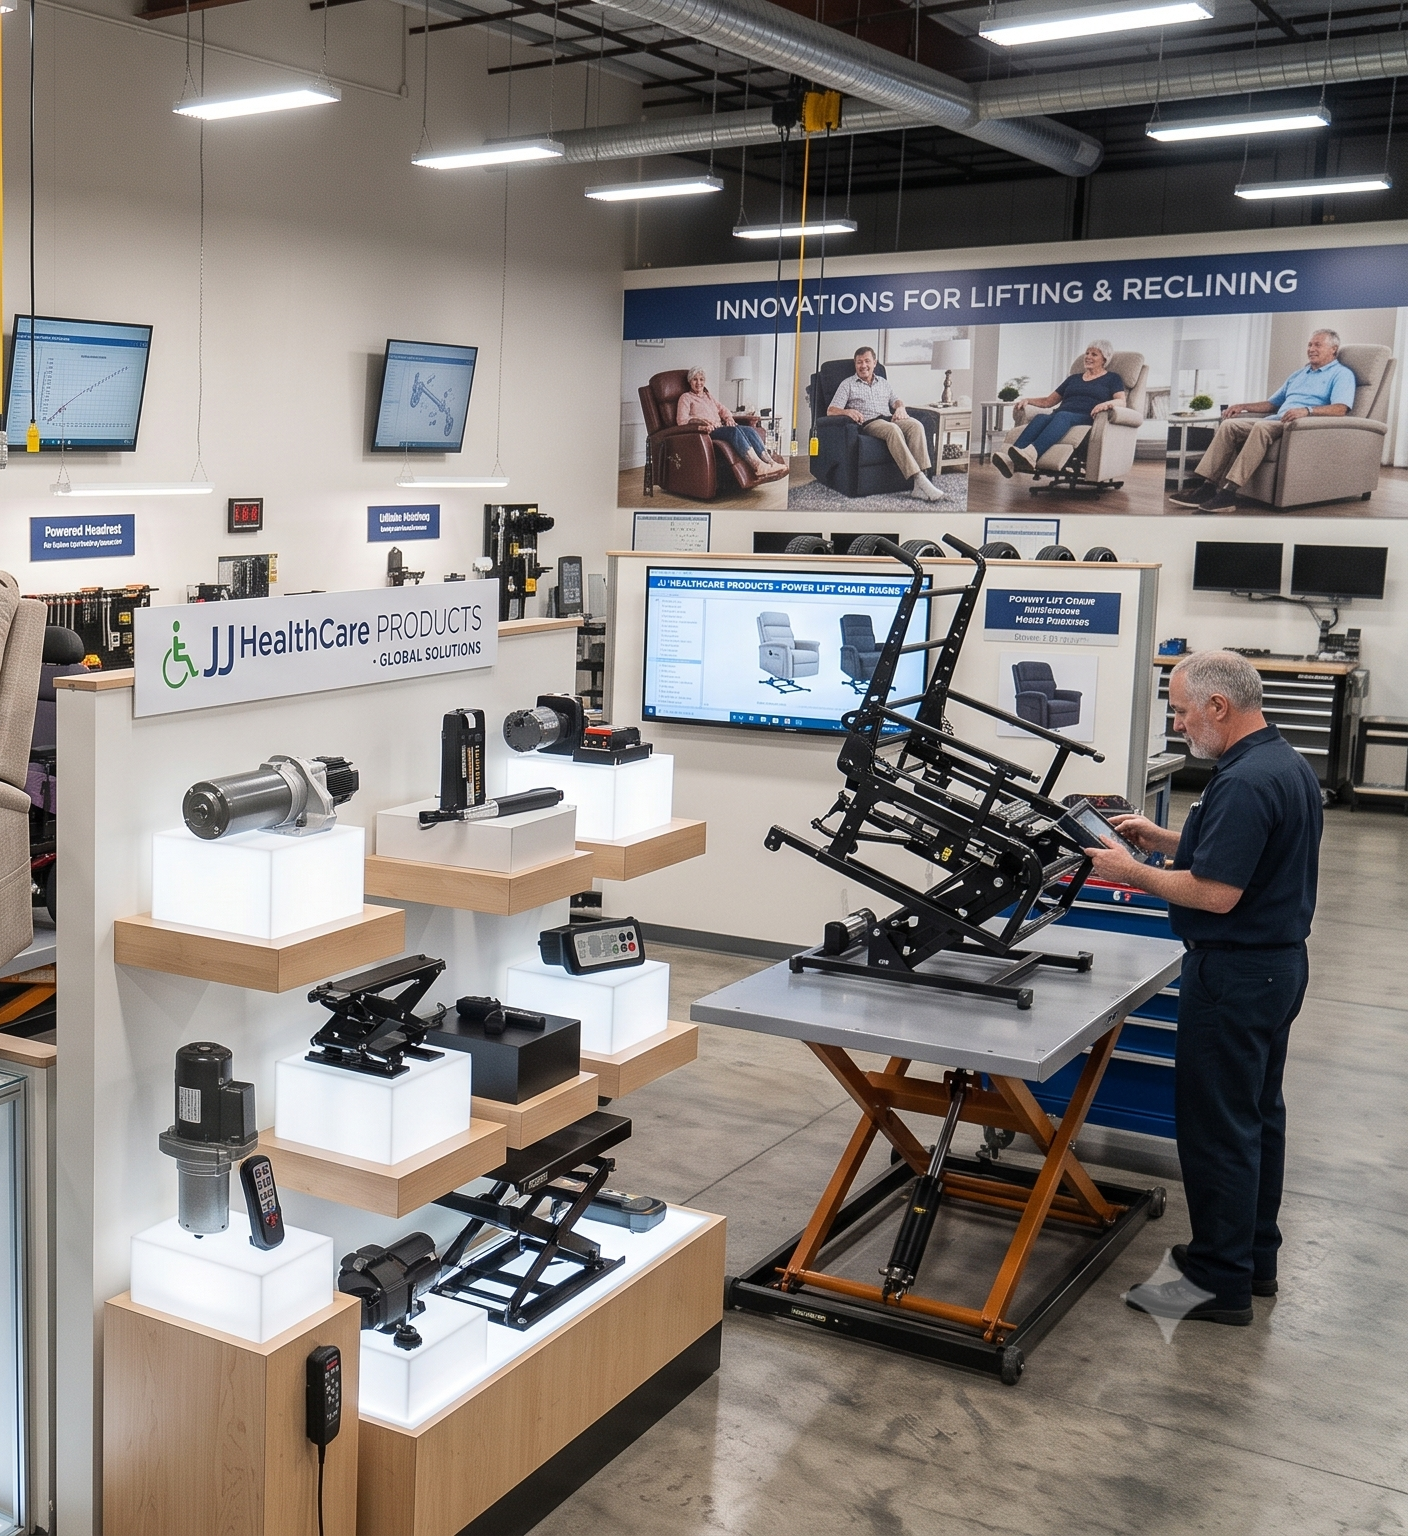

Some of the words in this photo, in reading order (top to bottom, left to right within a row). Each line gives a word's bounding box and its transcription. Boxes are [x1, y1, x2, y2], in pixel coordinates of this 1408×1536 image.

[716, 291, 894, 321] INNOVATIONS
[903, 288, 961, 311] FOR
[970, 280, 1083, 309] LIFTING
[1092, 279, 1113, 302] &
[1122, 269, 1298, 301] RECLINING
[45, 524, 83, 538] Powered
[84, 523, 122, 536] Headrest
[727, 581, 774, 590] PRODUCTS
[781, 583, 815, 592] POWER
[837, 585, 867, 594] CHAIR
[203, 624, 234, 677] JJ
[241, 618, 370, 659] HealthCare
[377, 605, 482, 643] PRODUCTS
[379, 648, 423, 667] GLOBAL
[425, 641, 482, 662] SOLUTIONS
